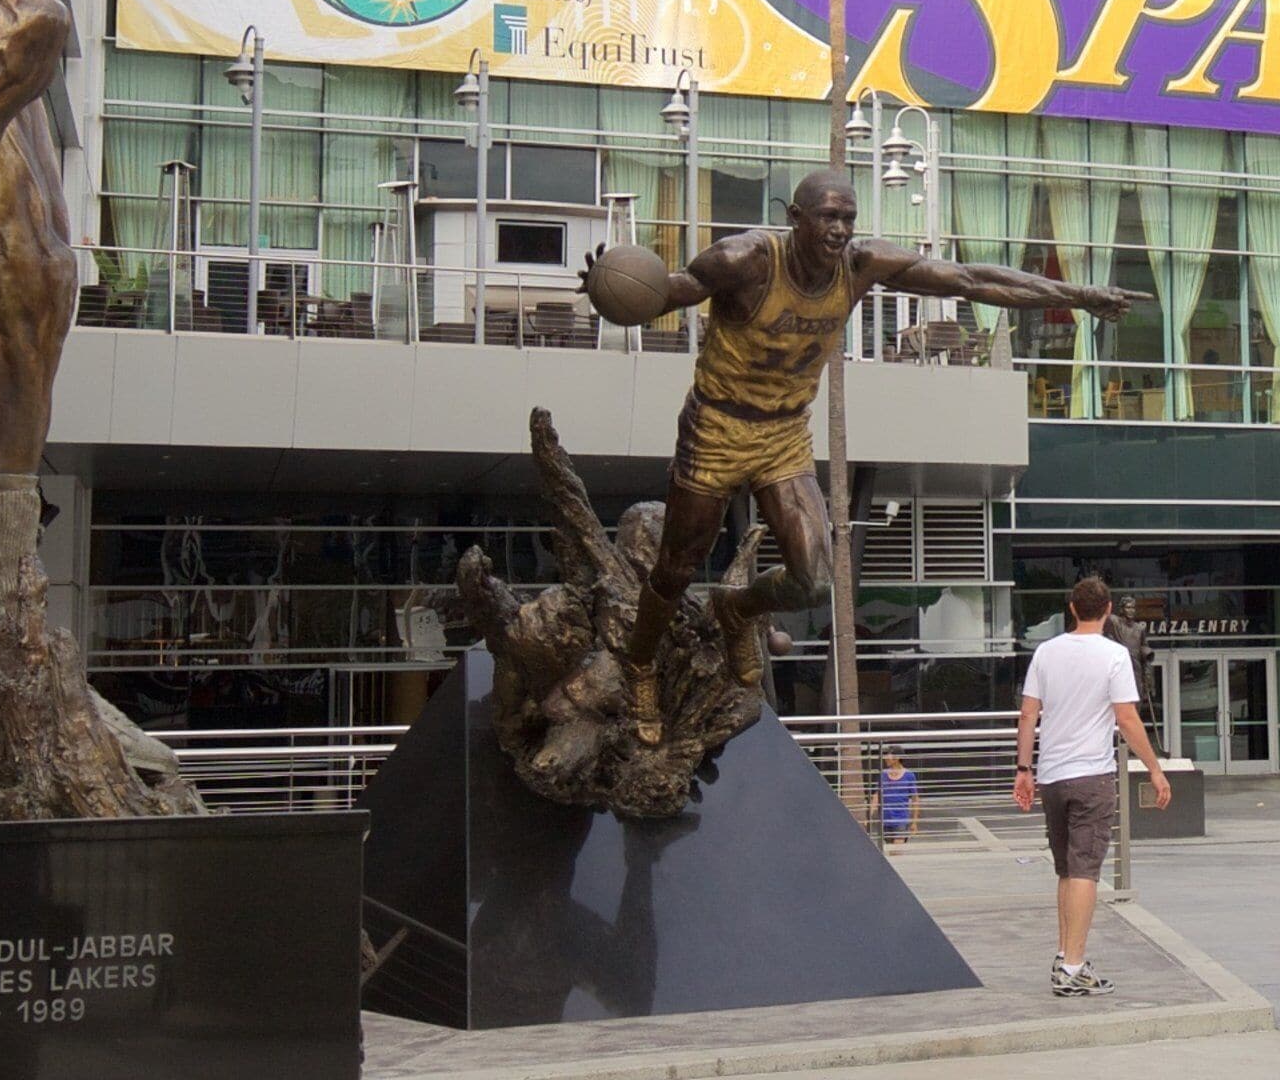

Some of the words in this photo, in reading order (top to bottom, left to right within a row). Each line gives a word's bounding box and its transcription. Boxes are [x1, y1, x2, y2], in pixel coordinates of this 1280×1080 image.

[543, 26, 706, 70] EquiTrust
[1139, 620, 1190, 635] PLAZA
[1197, 619, 1250, 634] ENTRY
[49, 963, 158, 992] LAKERS
[16, 998, 87, 1023] 1989
